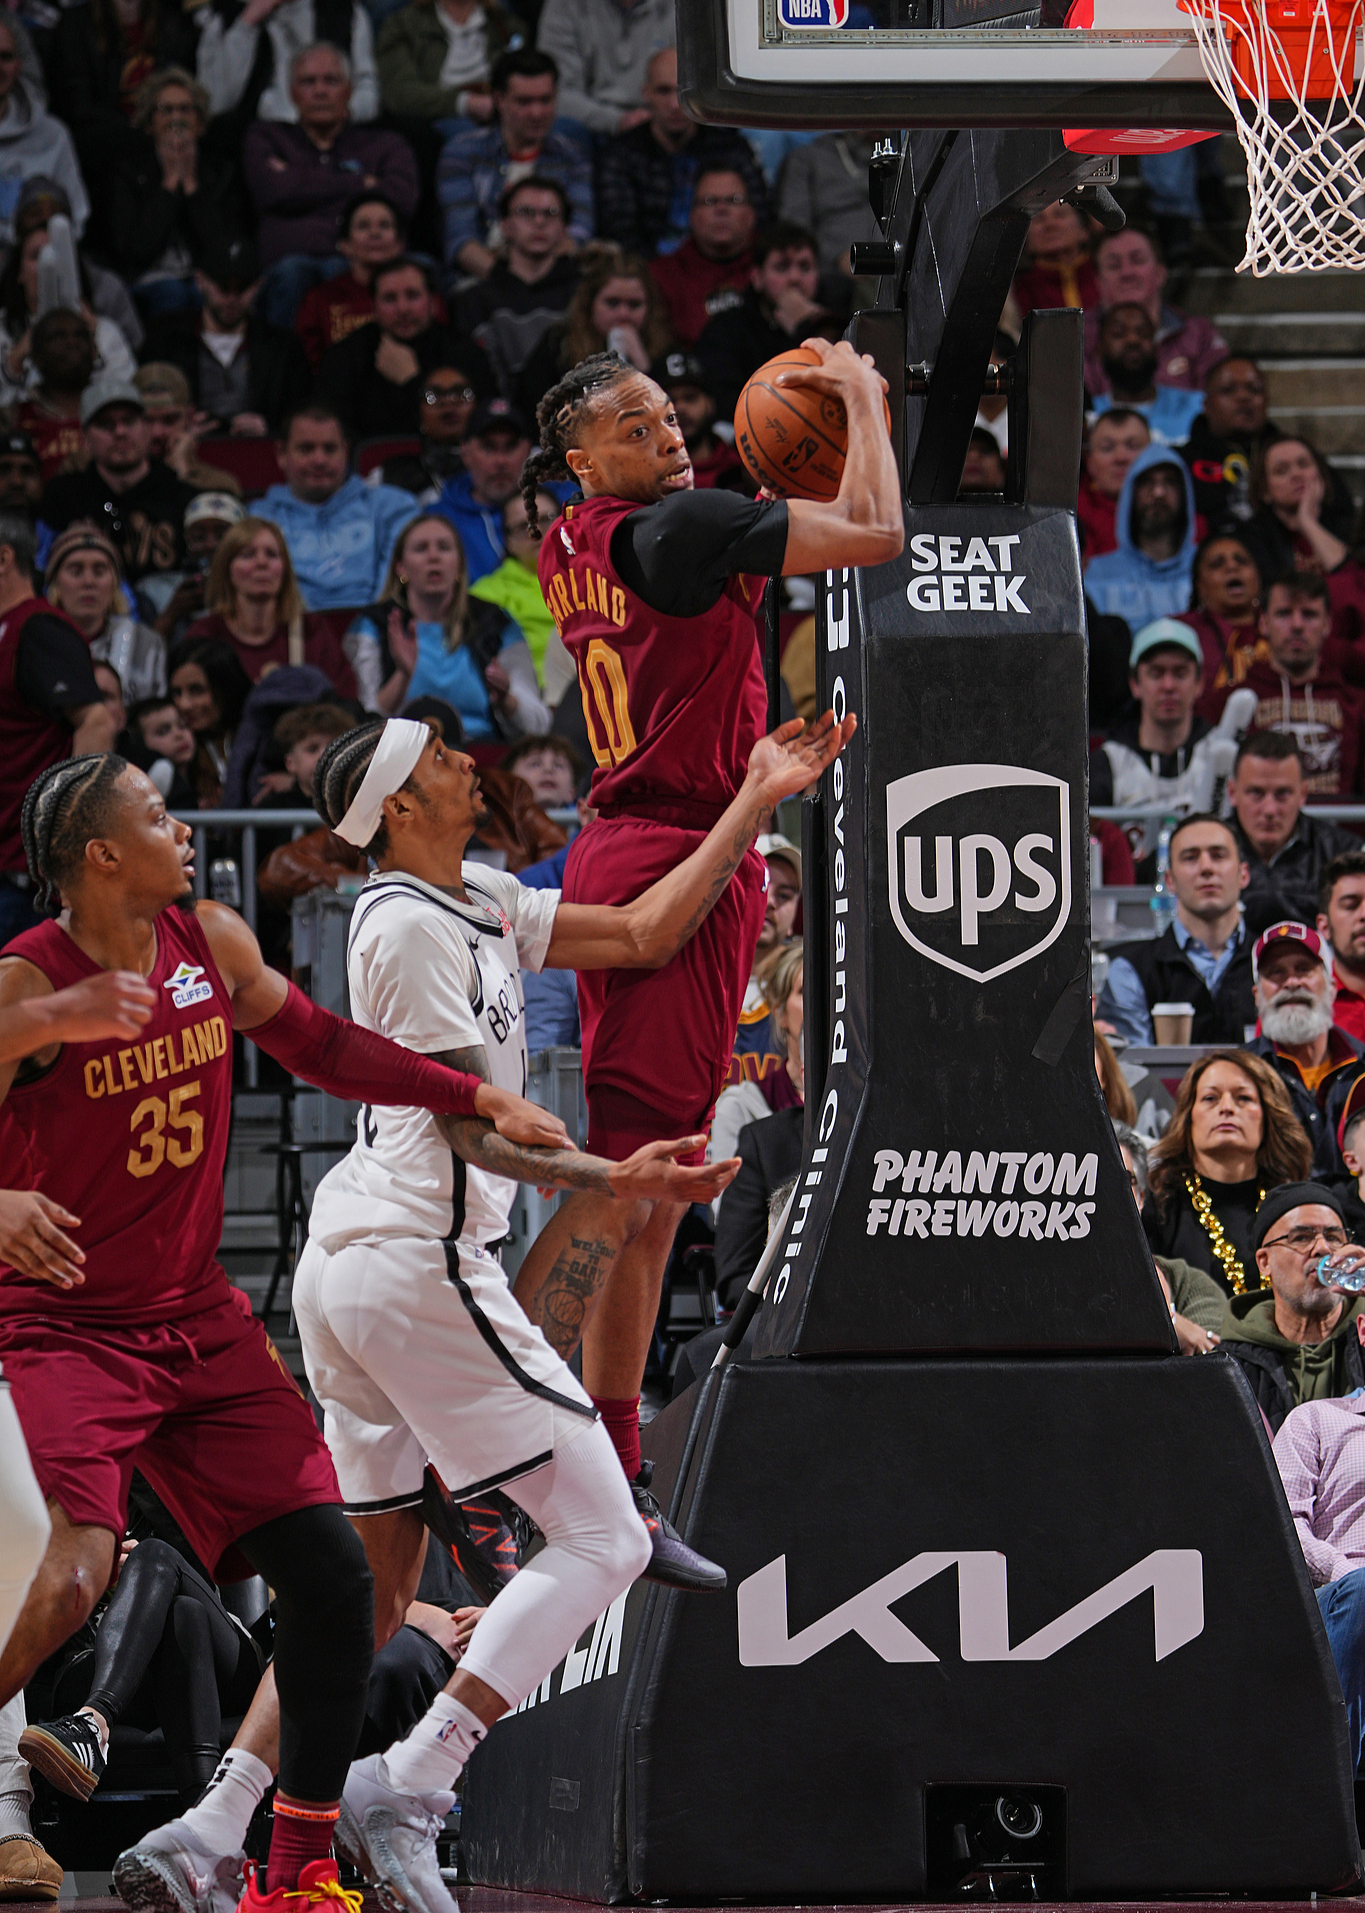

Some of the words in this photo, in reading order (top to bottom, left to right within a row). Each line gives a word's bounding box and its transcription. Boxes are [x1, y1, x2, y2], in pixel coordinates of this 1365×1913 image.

[788, 0, 822, 18] NBA
[910, 533, 1020, 572] SEAT
[906, 575, 1031, 614] GEEK
[831, 675, 849, 1066] Ceveland
[904, 833, 1057, 945] ups
[174, 986, 211, 1005] CLIFFS
[84, 1015, 228, 1099] CLEVELAND
[126, 1080, 204, 1179] 35
[872, 1149, 1099, 1196] PHANTOM
[773, 1088, 838, 1305] Clinic
[866, 1198, 1096, 1241] FIREWORKS
